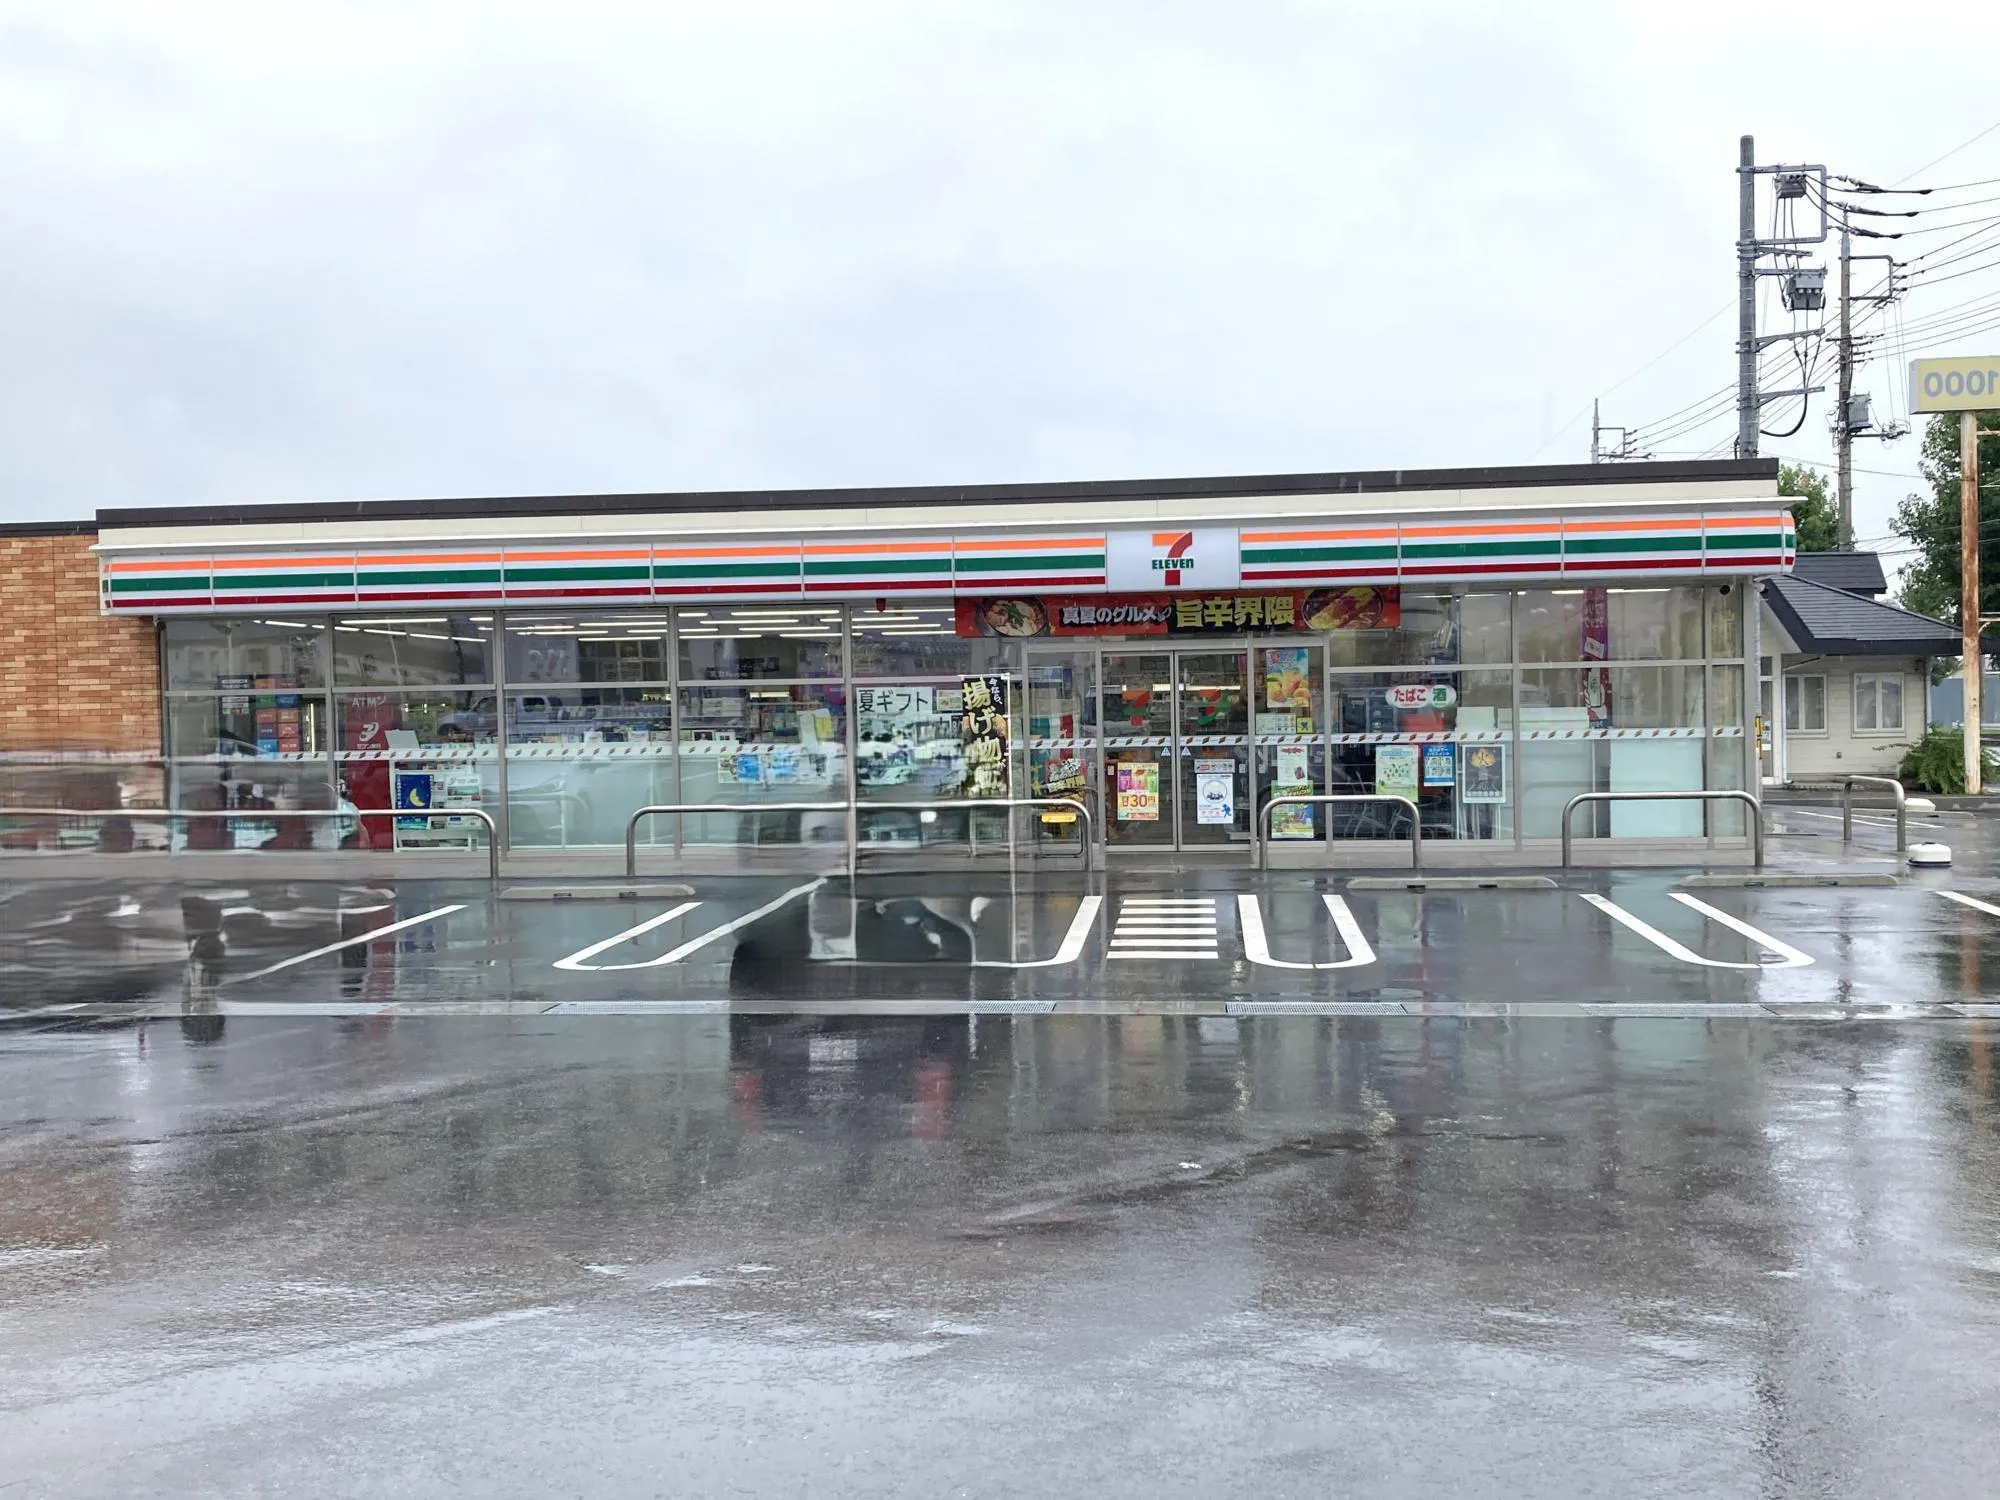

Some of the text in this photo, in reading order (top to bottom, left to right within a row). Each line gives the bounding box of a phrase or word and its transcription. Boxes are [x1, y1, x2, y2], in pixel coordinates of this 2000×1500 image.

[1152, 531, 1193, 586] 7
[1063, 596, 1295, 628] 真夏のグルメ 旨辛界隈
[352, 697, 377, 709] ATM
[858, 689, 929, 714] 夏ギフト
[988, 677, 1004, 706] 今なら、
[1394, 689, 1427, 702] たばこ
[1432, 687, 1447, 702] 酒
